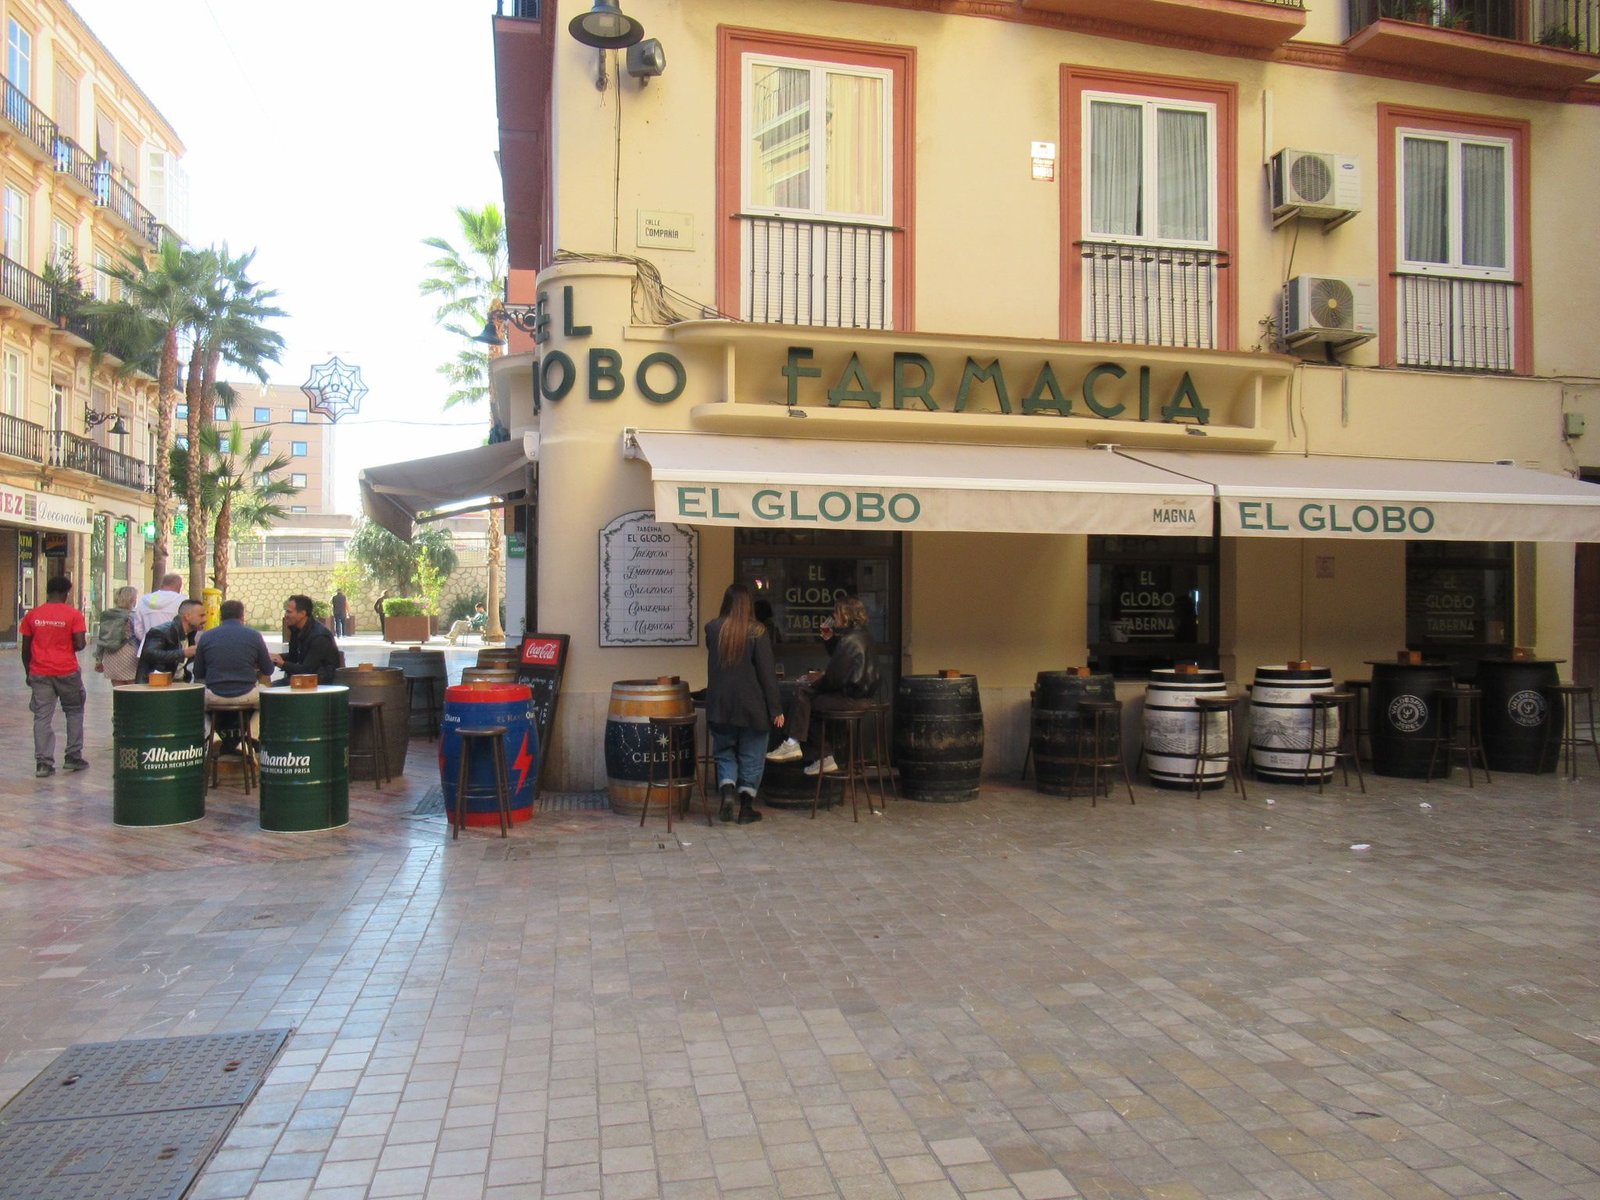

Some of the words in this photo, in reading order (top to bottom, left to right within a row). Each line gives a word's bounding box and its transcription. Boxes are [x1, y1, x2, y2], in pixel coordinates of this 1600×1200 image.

[535, 286, 593, 345] EL
[781, 346, 1210, 426] FARMACIA
[0, 491, 23, 516] EZ
[677, 486, 740, 521] EL
[751, 489, 921, 523] GLOBO
[1153, 508, 1196, 523] MAGNA
[1239, 501, 1289, 531] EL
[1299, 503, 1435, 534] GLOBO
[637, 525, 662, 533] TABERNA
[627, 534, 638, 543] EL
[640, 534, 671, 543] GLOBO
[808, 564, 826, 582] EL
[1140, 570, 1156, 586] EL
[785, 587, 847, 604] GLOBO
[1120, 591, 1175, 607] GLOBO
[1425, 594, 1475, 609] GLOBO
[1120, 617, 1175, 631] TABERNA
[1425, 618, 1475, 632] TABERNA
[1390, 697, 1426, 717] VALDESPINO
[141, 744, 204, 765] Alhambra
[631, 749, 691, 764] CELESTE
[144, 762, 168, 770] CERVEZA
[294, 767, 311, 775] PRISA
